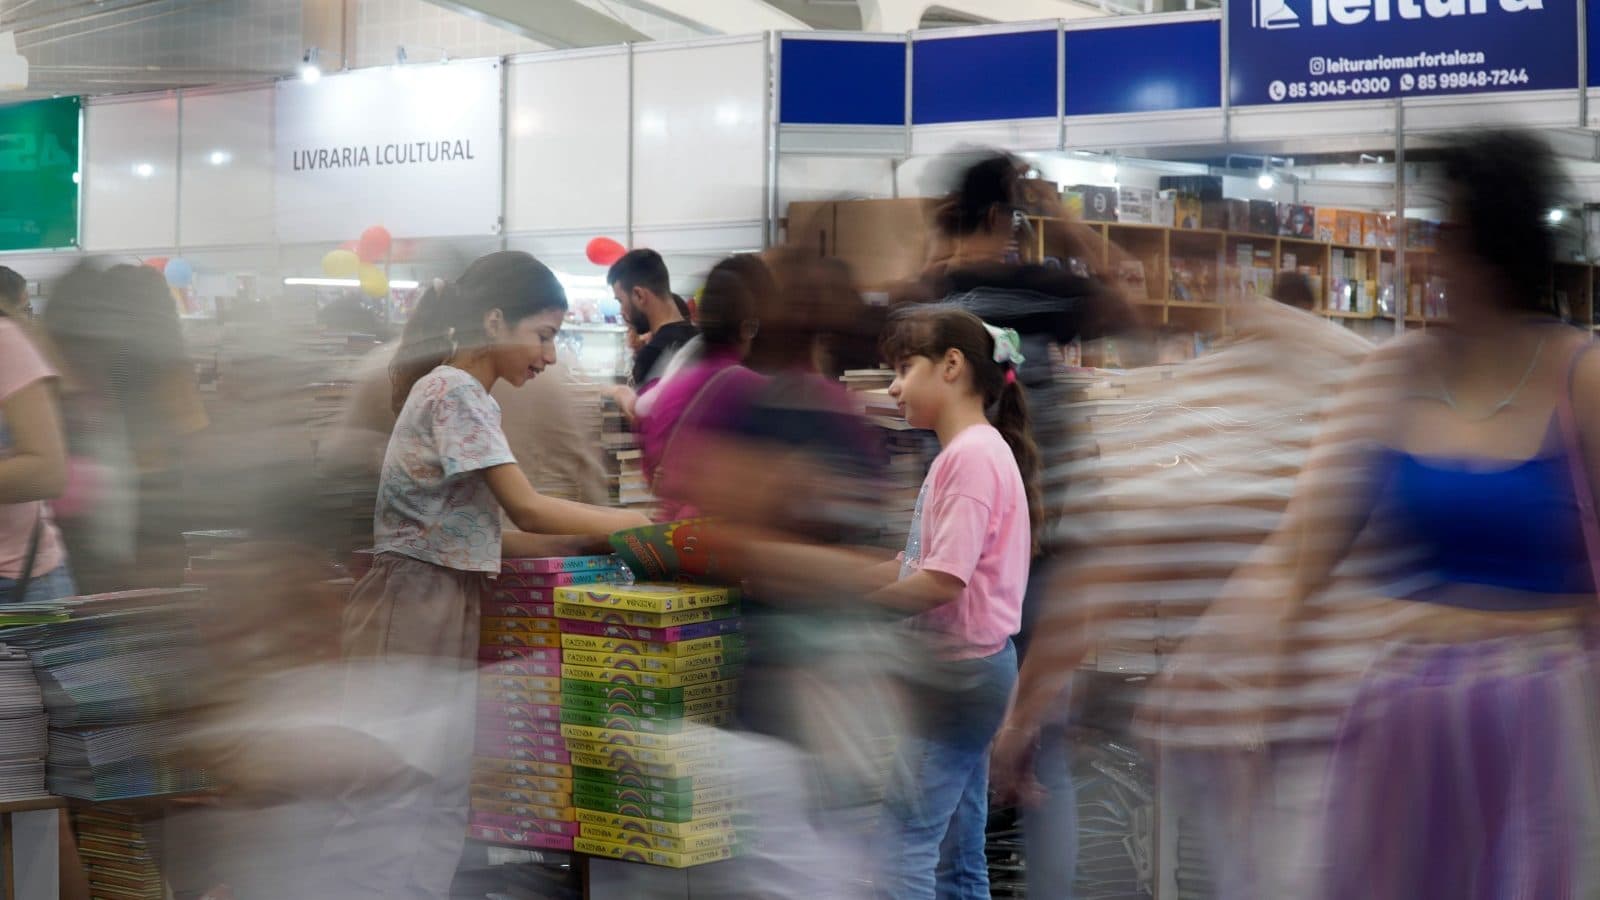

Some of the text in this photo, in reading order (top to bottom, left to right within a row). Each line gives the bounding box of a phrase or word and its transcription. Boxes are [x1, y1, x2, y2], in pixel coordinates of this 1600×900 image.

[1326, 50, 1485, 73] leiturariomarfortaleza
[1288, 77, 1391, 97] 85 3045-0300
[1417, 68, 1529, 89] 85 99848-7244
[293, 139, 475, 171] LIVRARIA LCULTURAL
